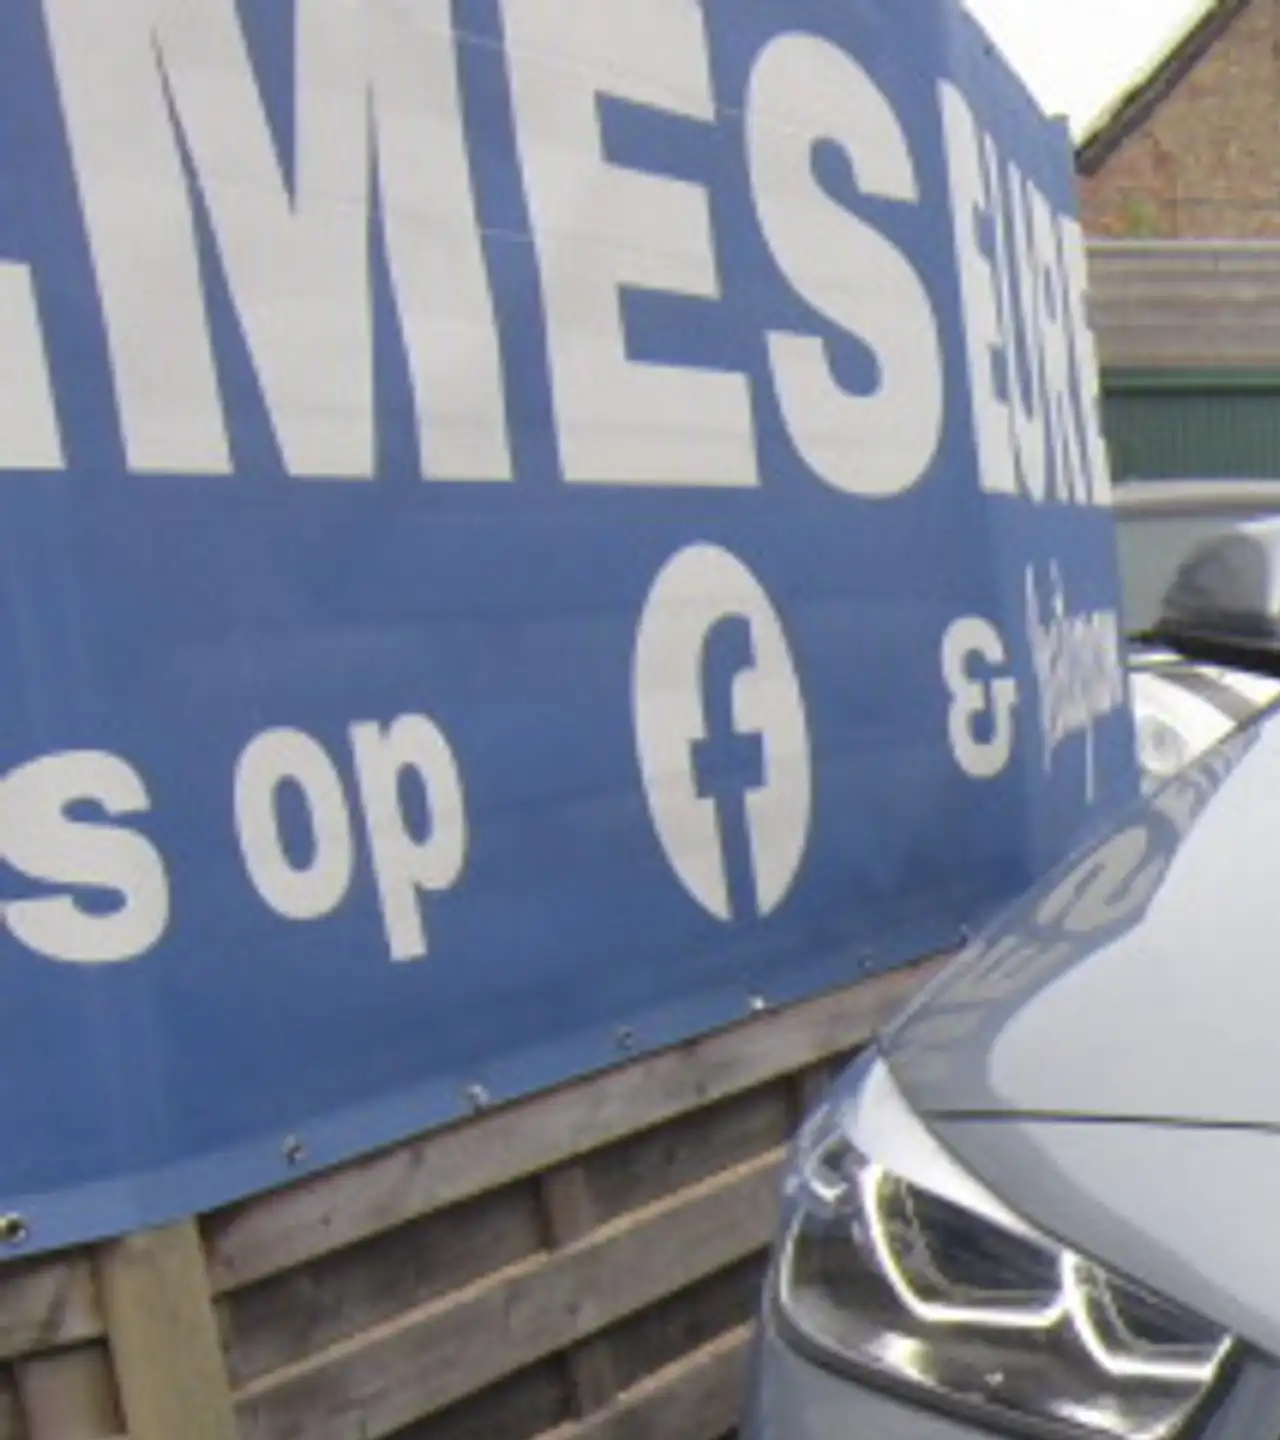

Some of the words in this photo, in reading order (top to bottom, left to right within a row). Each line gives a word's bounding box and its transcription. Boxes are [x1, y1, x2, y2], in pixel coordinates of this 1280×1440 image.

[0, 0, 944, 499] MES
[233, 712, 469, 961] op
[940, 614, 1019, 779] &
